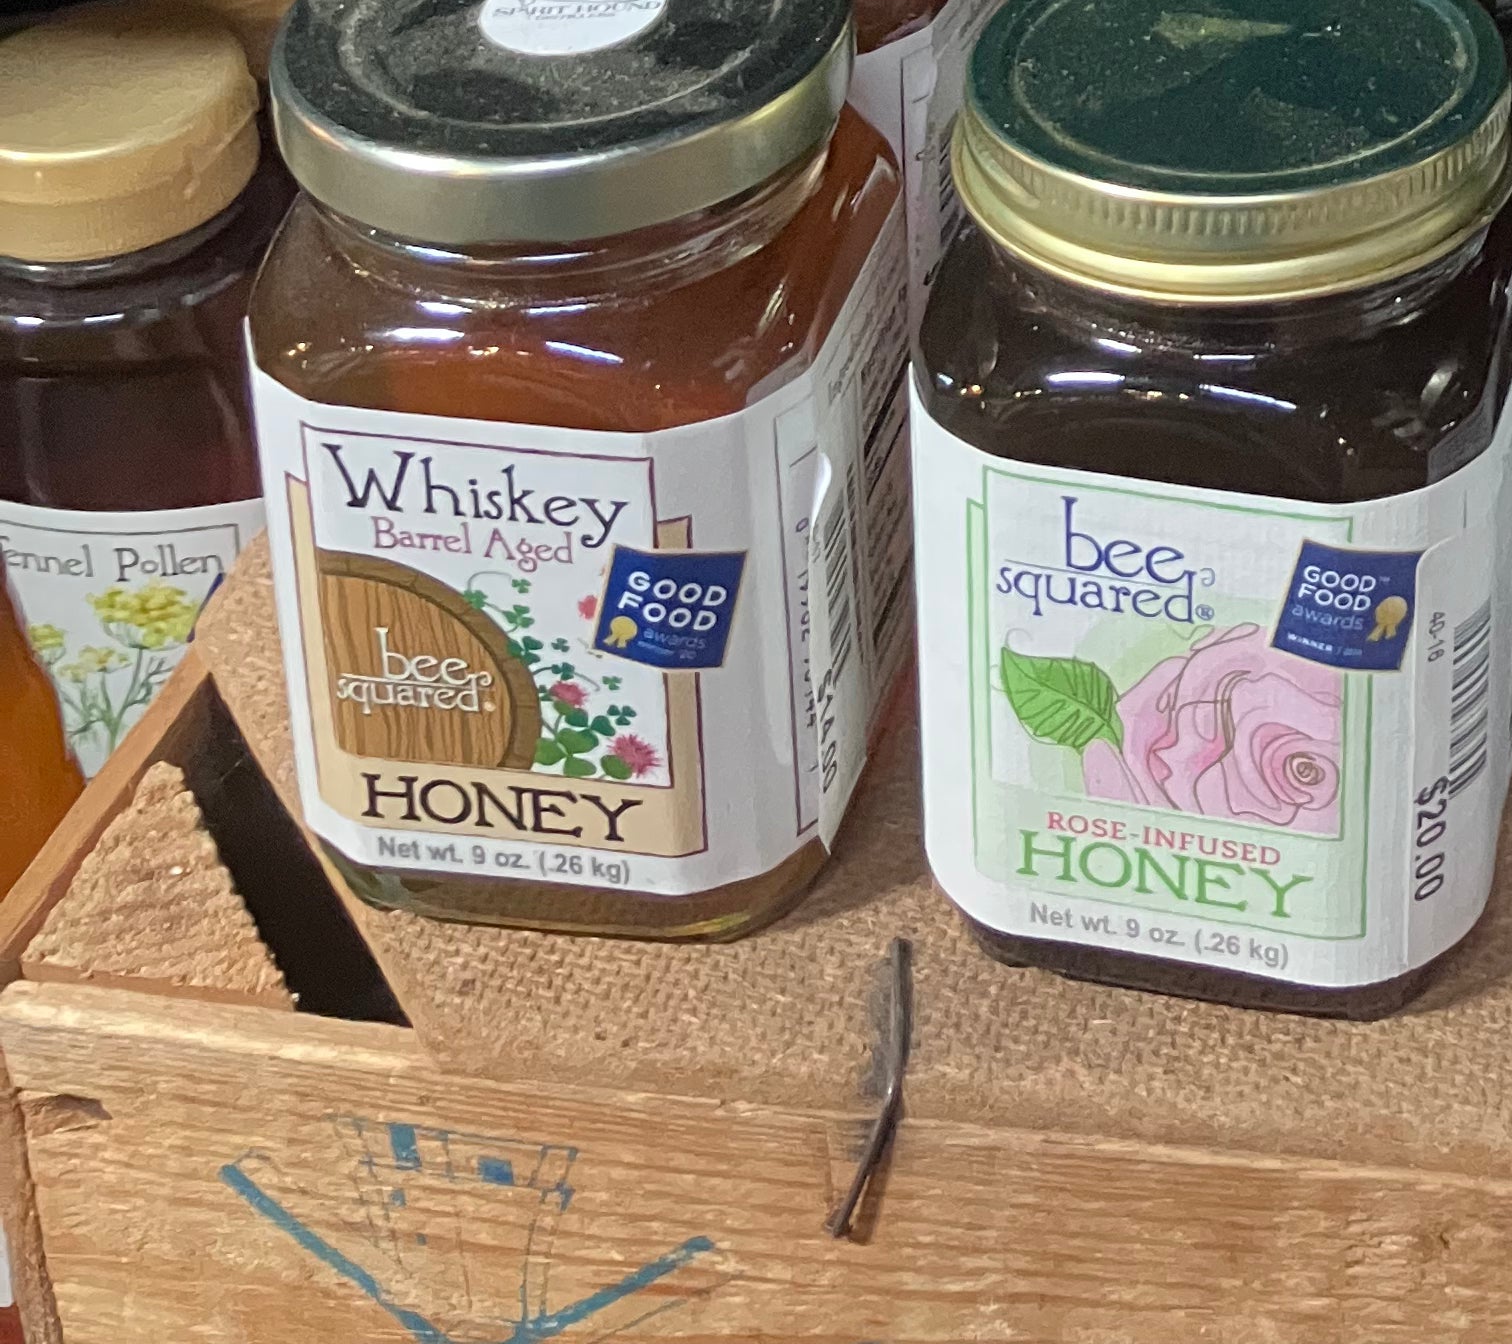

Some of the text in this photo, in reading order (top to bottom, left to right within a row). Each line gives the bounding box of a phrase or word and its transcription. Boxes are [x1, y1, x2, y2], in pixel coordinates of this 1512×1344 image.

[323, 443, 630, 550] Whiskey
[114, 542, 225, 582] Pollen
[370, 516, 574, 573] Barrel Aged
[1062, 496, 1185, 585] bee
[628, 570, 727, 607] GOOD
[1298, 583, 1371, 611] FOOD
[1303, 565, 1376, 592] GOOD
[617, 590, 717, 631] FOOD
[1291, 604, 1364, 631] awards
[378, 627, 472, 685] bee
[643, 627, 706, 650] awards
[362, 773, 643, 842] HONEY
[378, 836, 630, 885] Net wt. 9 oz. (.26 kg)
[1046, 811, 1282, 866] ROSE-INFUSED
[1413, 775, 1450, 901] $20.00
[1016, 829, 1313, 918] HONEY
[1029, 902, 1289, 970] Net wt. 9 oz. (.26 kg)
